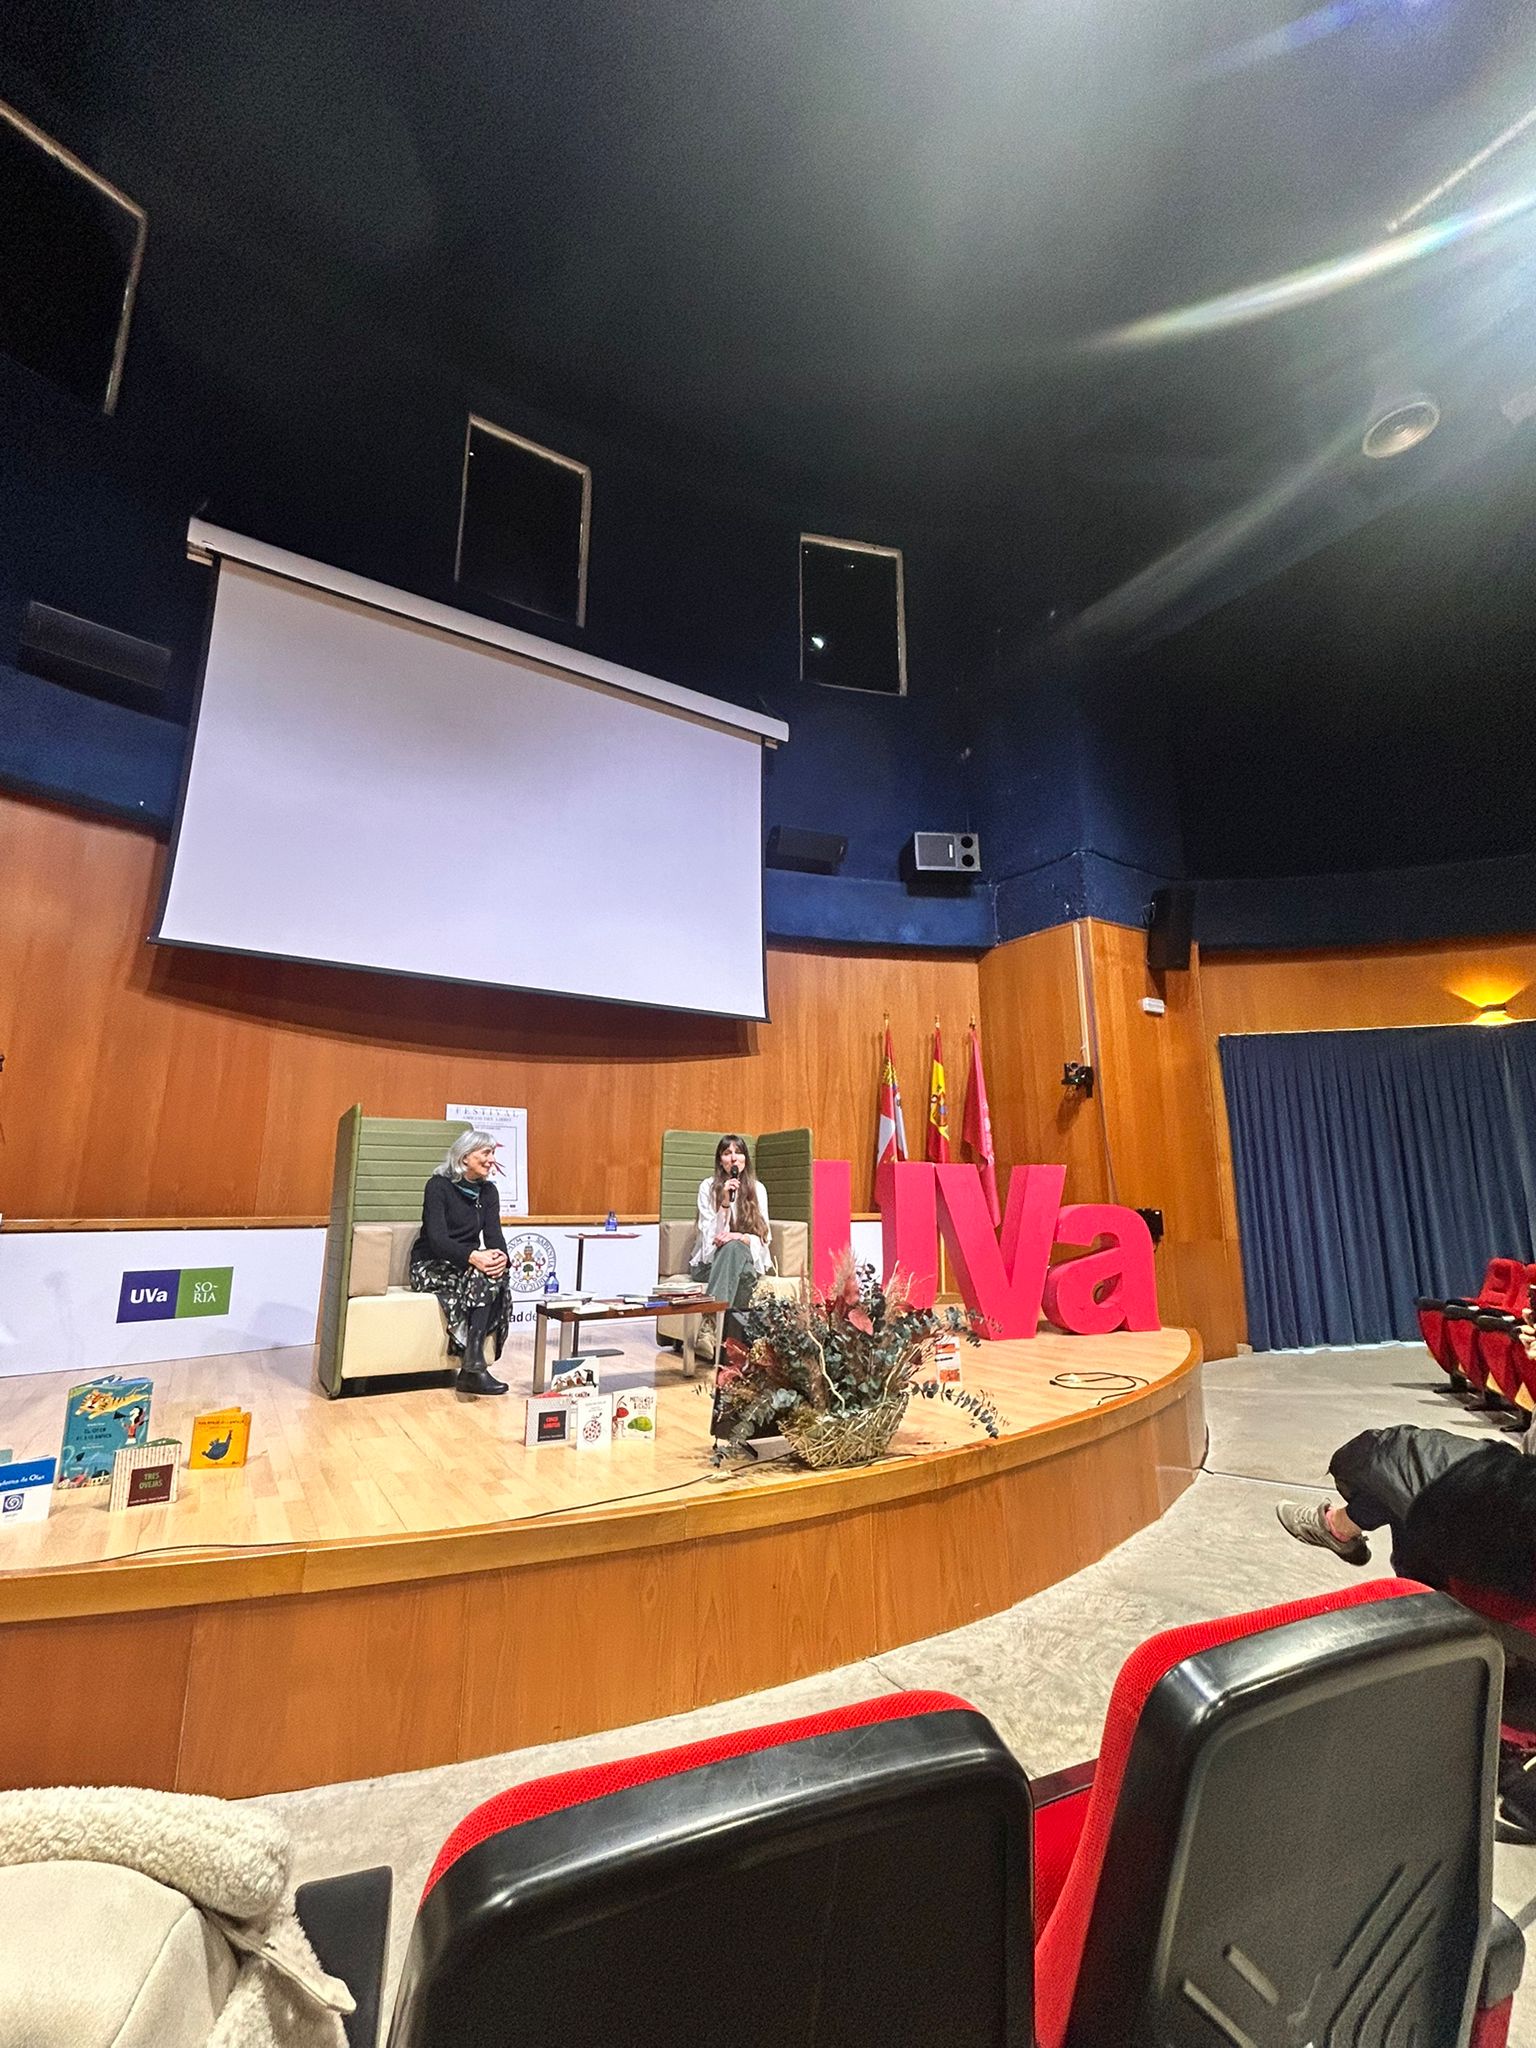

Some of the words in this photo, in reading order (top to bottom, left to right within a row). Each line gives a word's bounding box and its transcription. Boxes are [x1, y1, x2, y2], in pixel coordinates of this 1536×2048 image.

[455, 1106, 519, 1118] FESTIVAL
[812, 1159, 1161, 1340] UVa
[130, 1288, 168, 1304] UVa
[193, 1291, 217, 1304] RIA
[144, 1472, 160, 1480] TRES
[139, 1480, 163, 1489] OVEJAS
